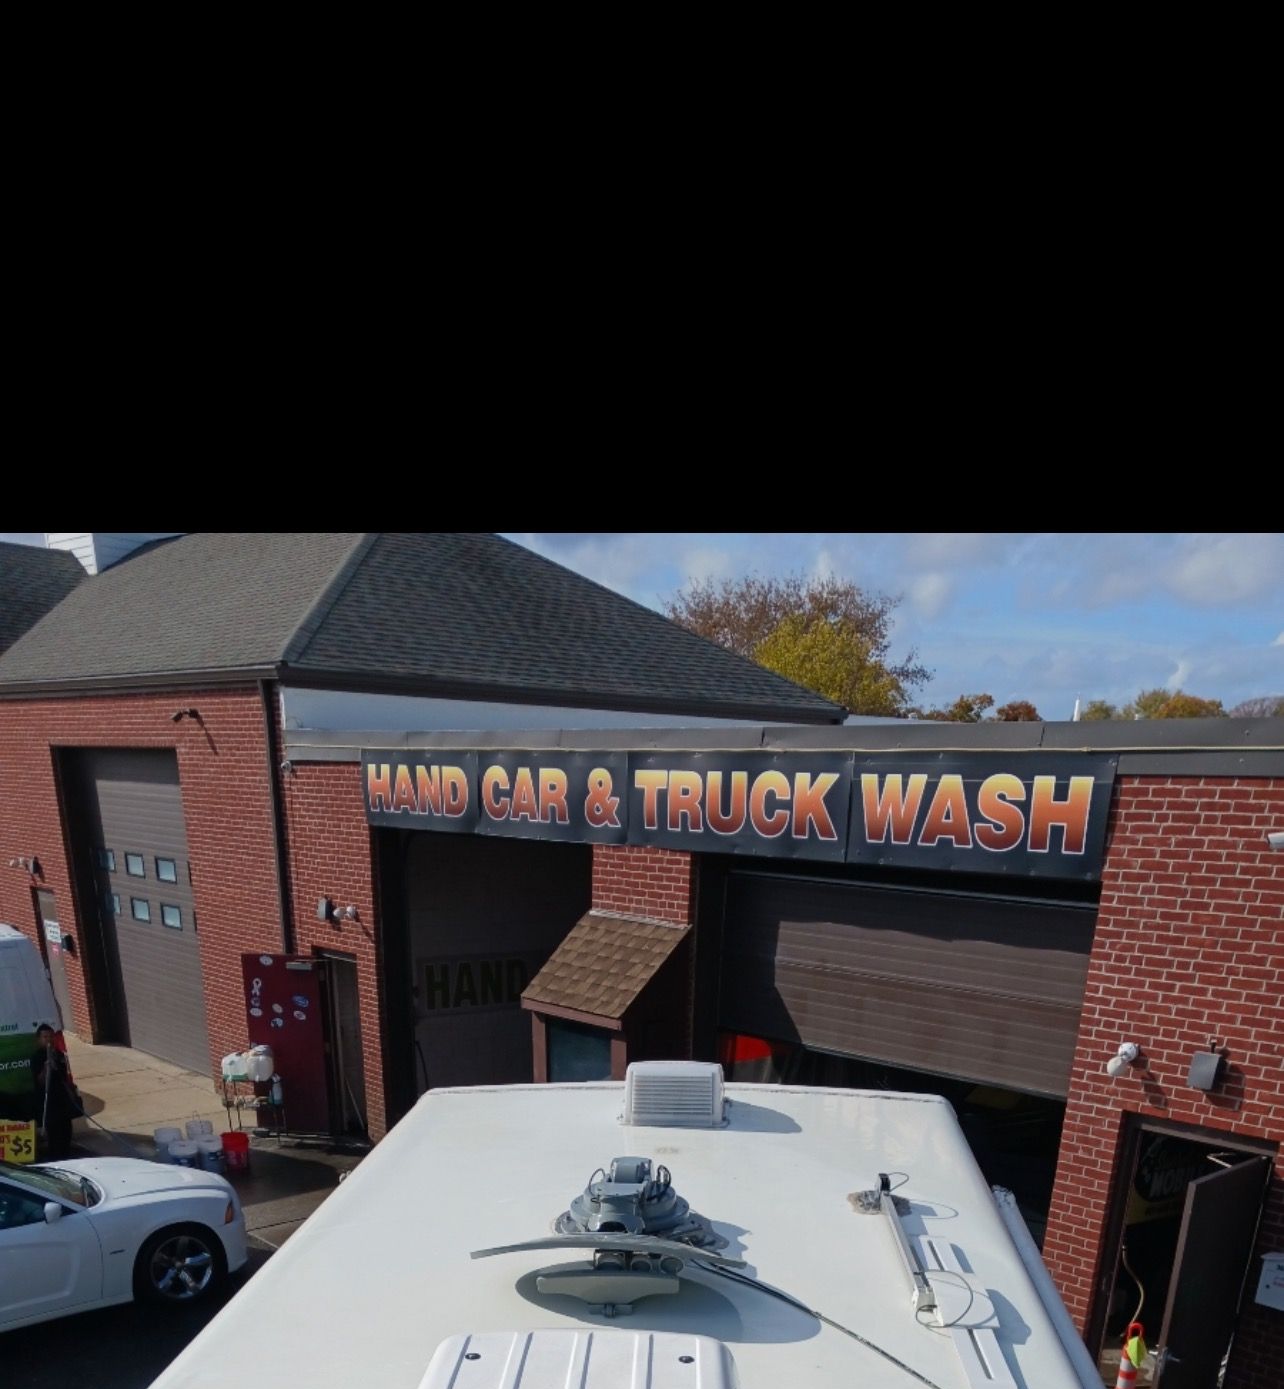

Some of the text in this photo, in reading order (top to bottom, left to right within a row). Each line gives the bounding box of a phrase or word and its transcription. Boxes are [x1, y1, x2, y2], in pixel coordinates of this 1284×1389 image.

[366, 762, 1095, 855] HAND CAR & TRUCK WASH
[424, 957, 529, 1010] HAND
[10, 1136, 32, 1157] $5
